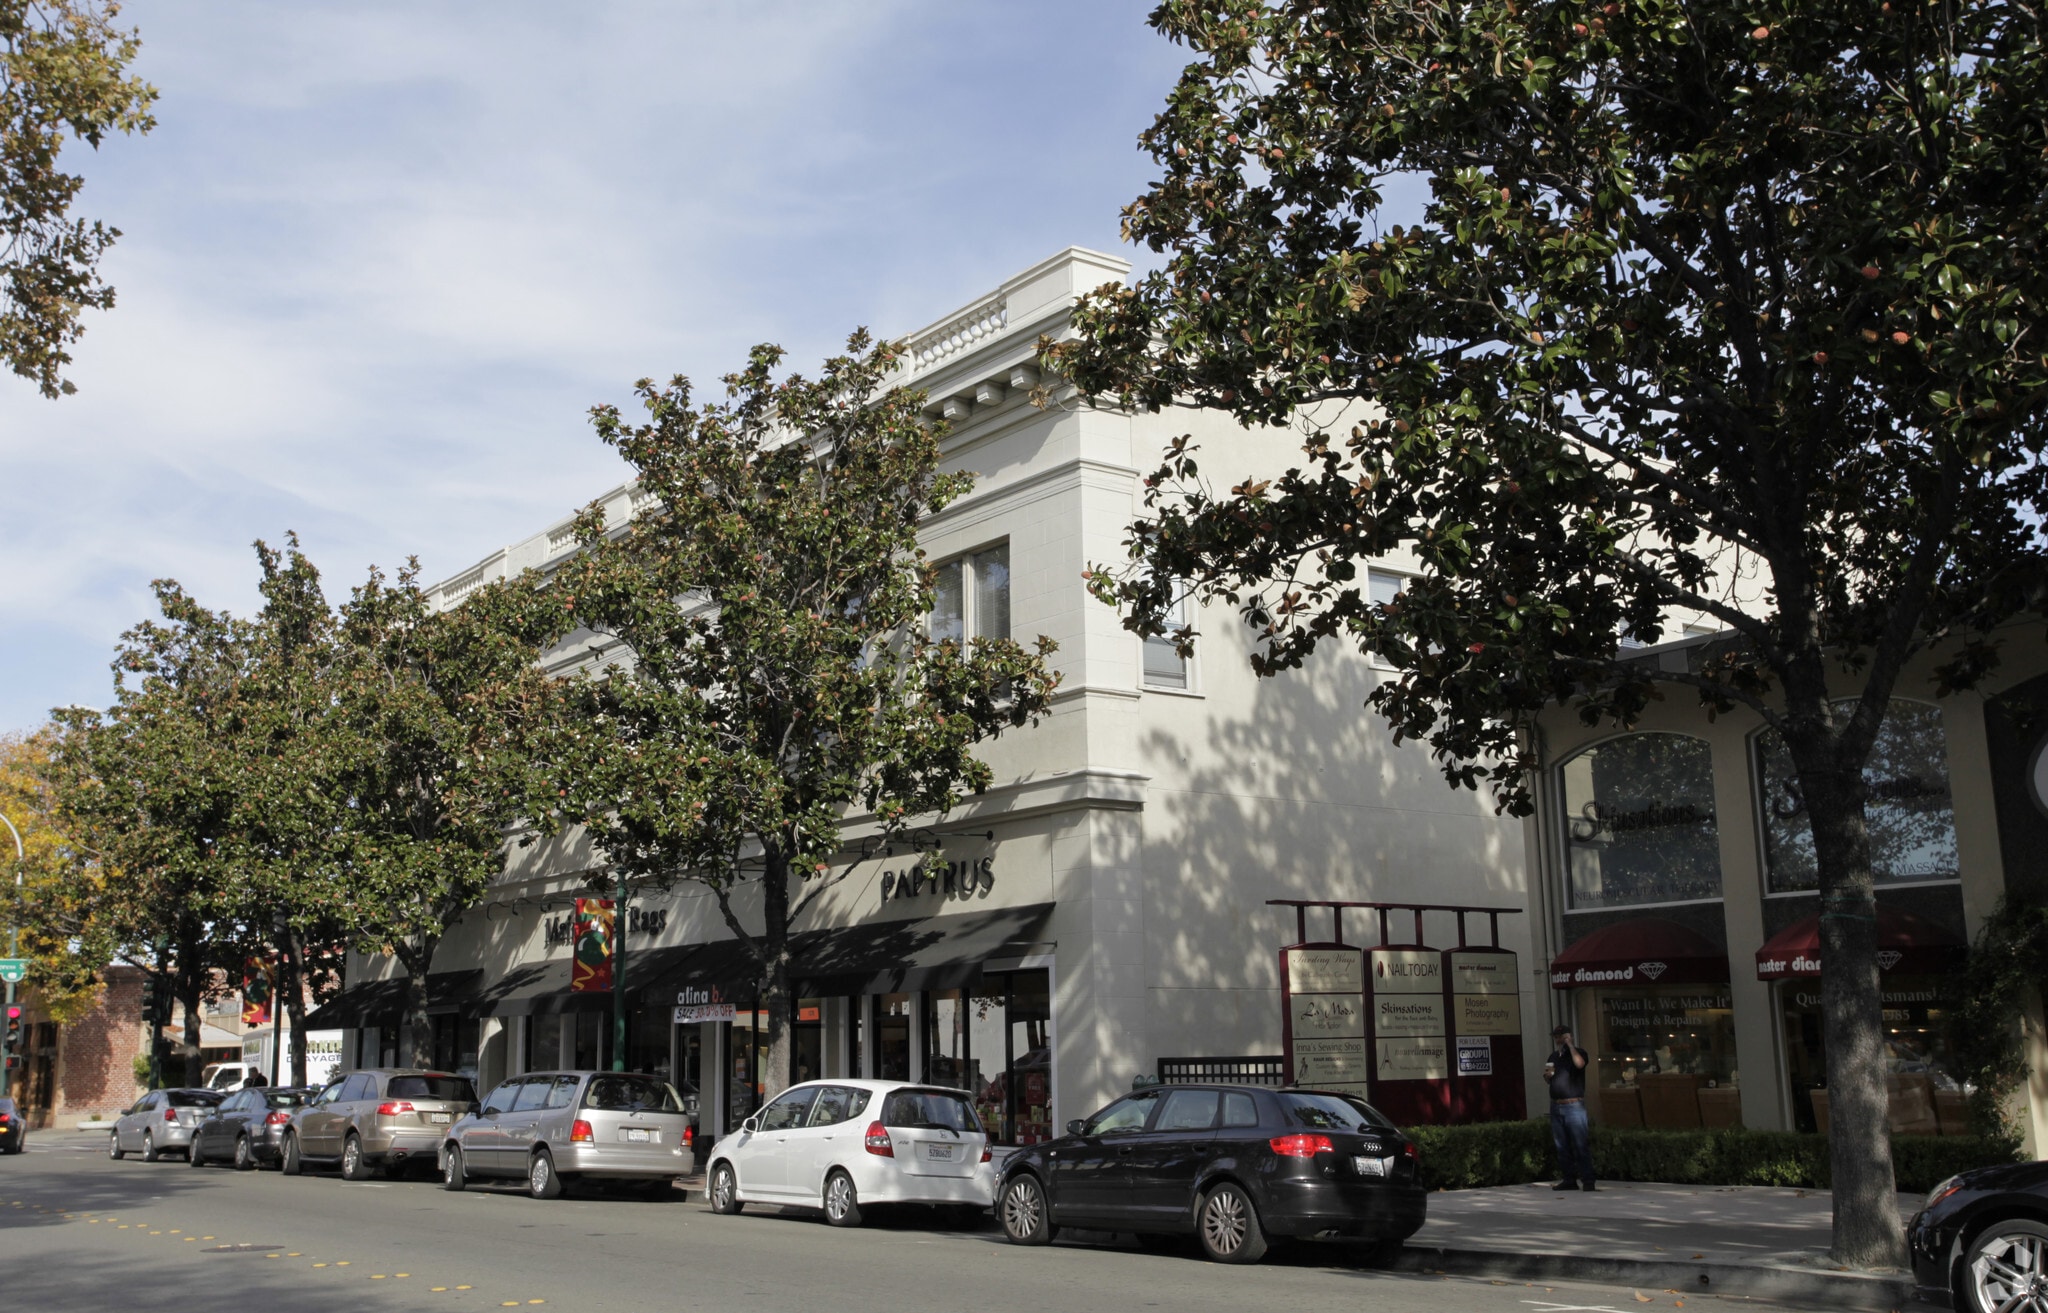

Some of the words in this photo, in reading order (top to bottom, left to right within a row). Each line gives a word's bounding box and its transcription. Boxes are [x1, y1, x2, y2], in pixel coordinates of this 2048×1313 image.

[883, 857, 994, 901] PAPYRUS
[1574, 966, 1634, 983] diamond
[677, 986, 709, 1005] alina
[1659, 996, 1677, 1009] We
[1680, 995, 1713, 1008] Make
[720, 1004, 733, 1017] OFF
[1611, 1015, 1649, 1029] Designs
[1652, 1015, 1661, 1026] &
[1664, 1013, 1702, 1028] Repairs
